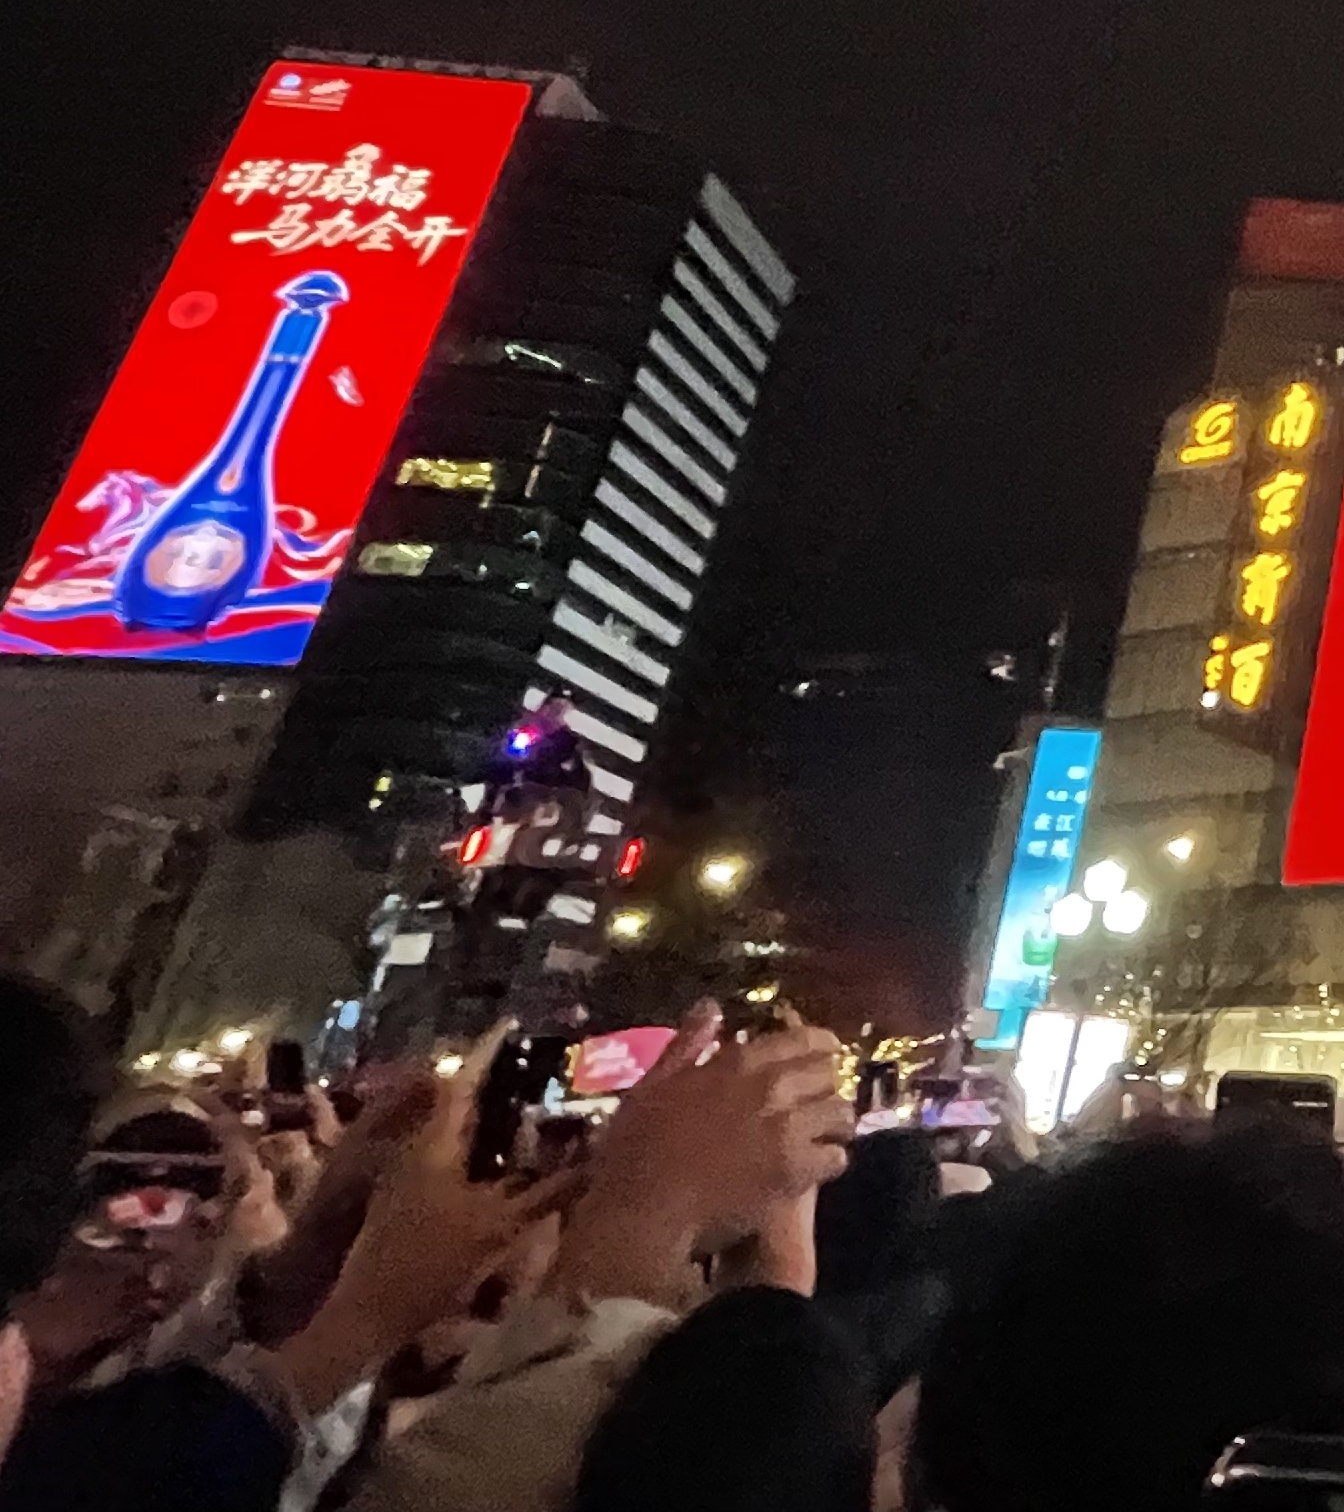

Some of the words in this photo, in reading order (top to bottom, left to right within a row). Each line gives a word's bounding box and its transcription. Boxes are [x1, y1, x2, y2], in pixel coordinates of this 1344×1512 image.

[230, 203, 468, 267] 马力全开
[1230, 381, 1317, 708] 南京新百
